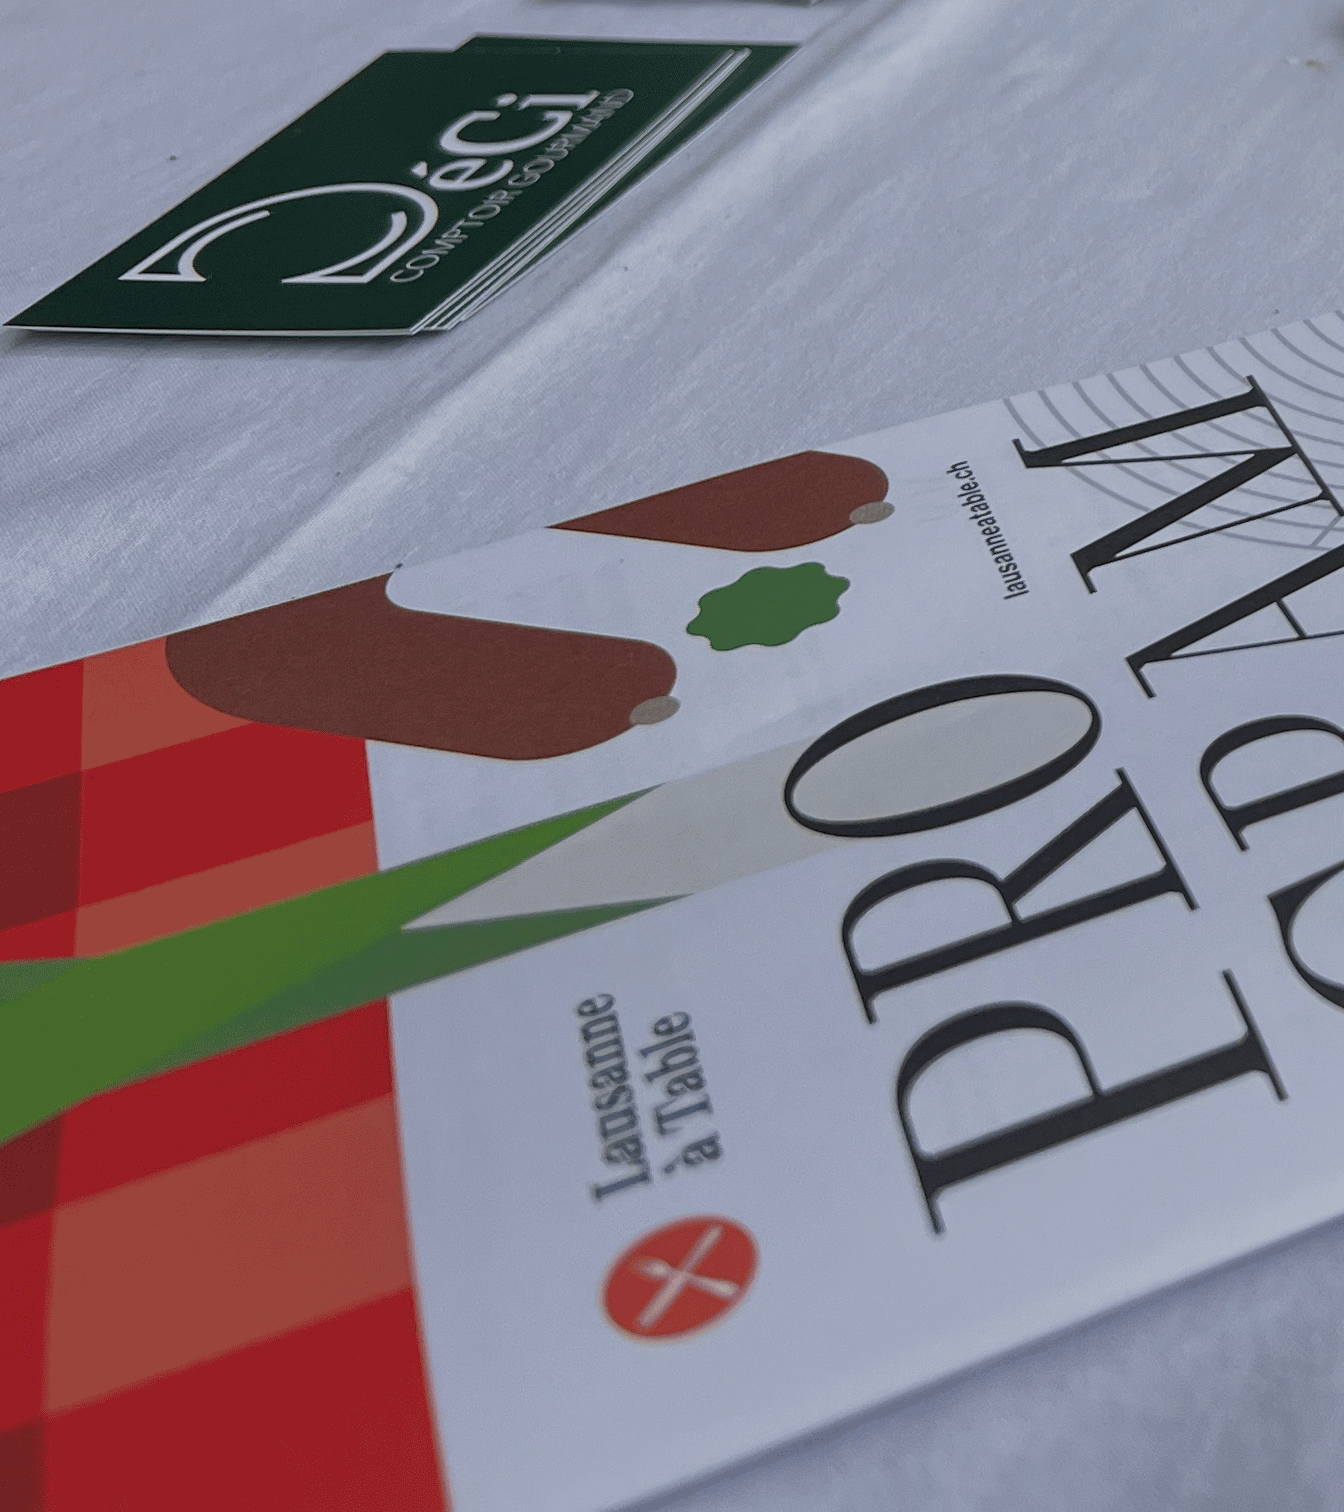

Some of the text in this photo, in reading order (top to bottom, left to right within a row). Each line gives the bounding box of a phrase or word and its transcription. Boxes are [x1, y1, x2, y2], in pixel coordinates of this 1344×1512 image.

[390, 88, 634, 282] COMPTOIR GOURMAND
[946, 460, 1029, 599] lausanneatable.ch
[784, 673, 1288, 1236] PRO
[576, 993, 652, 1203] Lausanne
[639, 1011, 723, 1175] à Table
